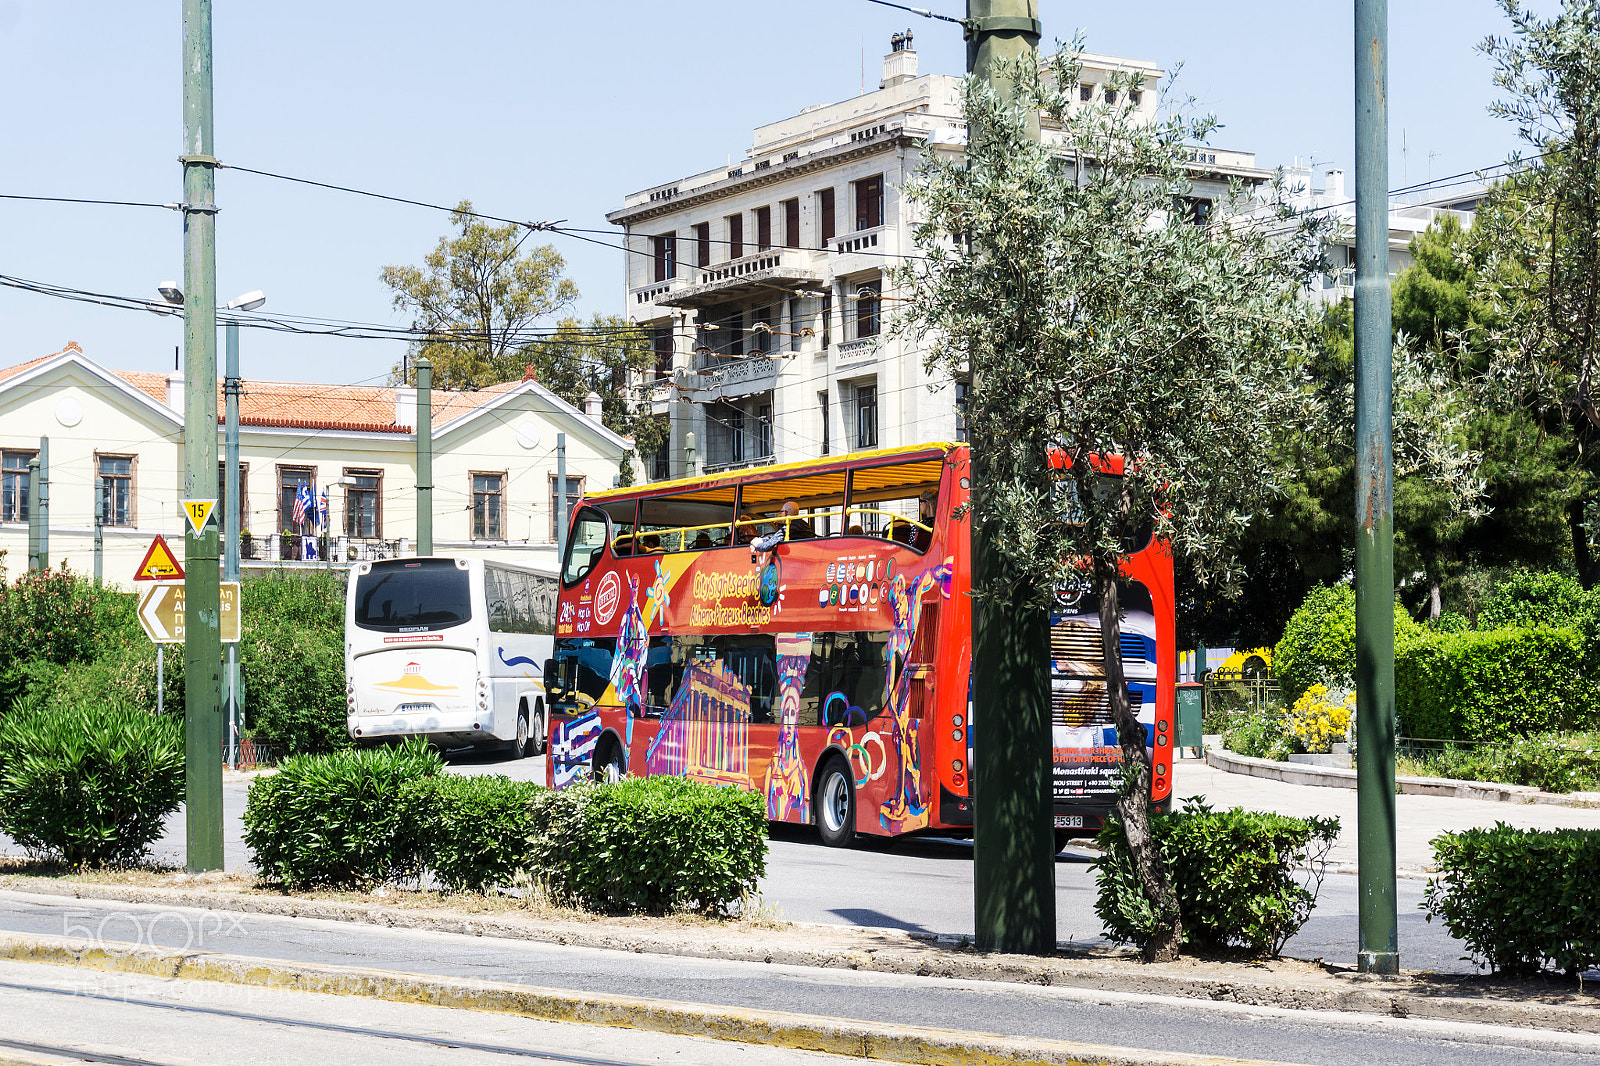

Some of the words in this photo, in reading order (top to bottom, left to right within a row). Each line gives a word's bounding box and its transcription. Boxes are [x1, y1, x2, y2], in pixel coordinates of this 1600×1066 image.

[192, 504, 204, 518] 15
[1081, 747, 1096, 755] OUR
[1053, 767, 1098, 775] Monastiraki
